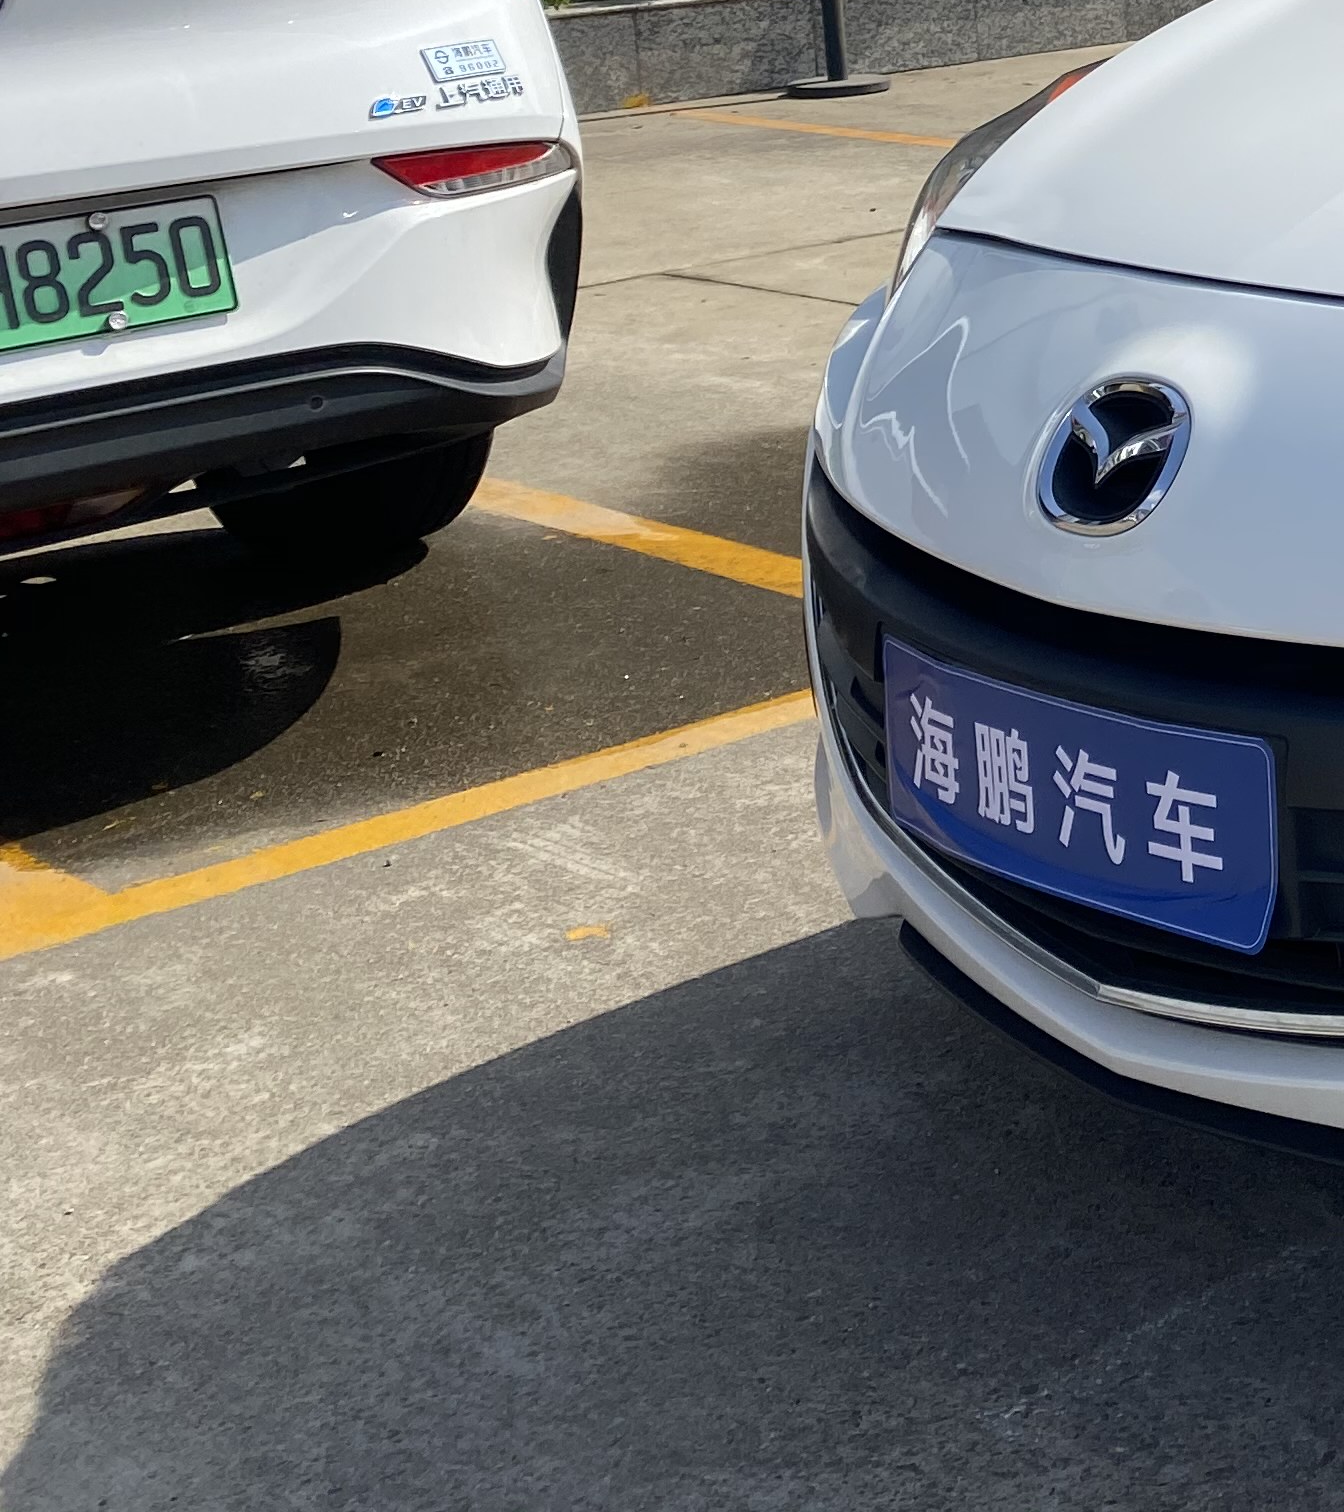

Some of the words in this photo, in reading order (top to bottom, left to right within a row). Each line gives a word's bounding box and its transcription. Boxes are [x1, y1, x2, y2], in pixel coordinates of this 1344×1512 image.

[402, 96, 424, 110] EV
[435, 74, 525, 111] 上汽通用
[909, 692, 1225, 884] 海鹏汽车
